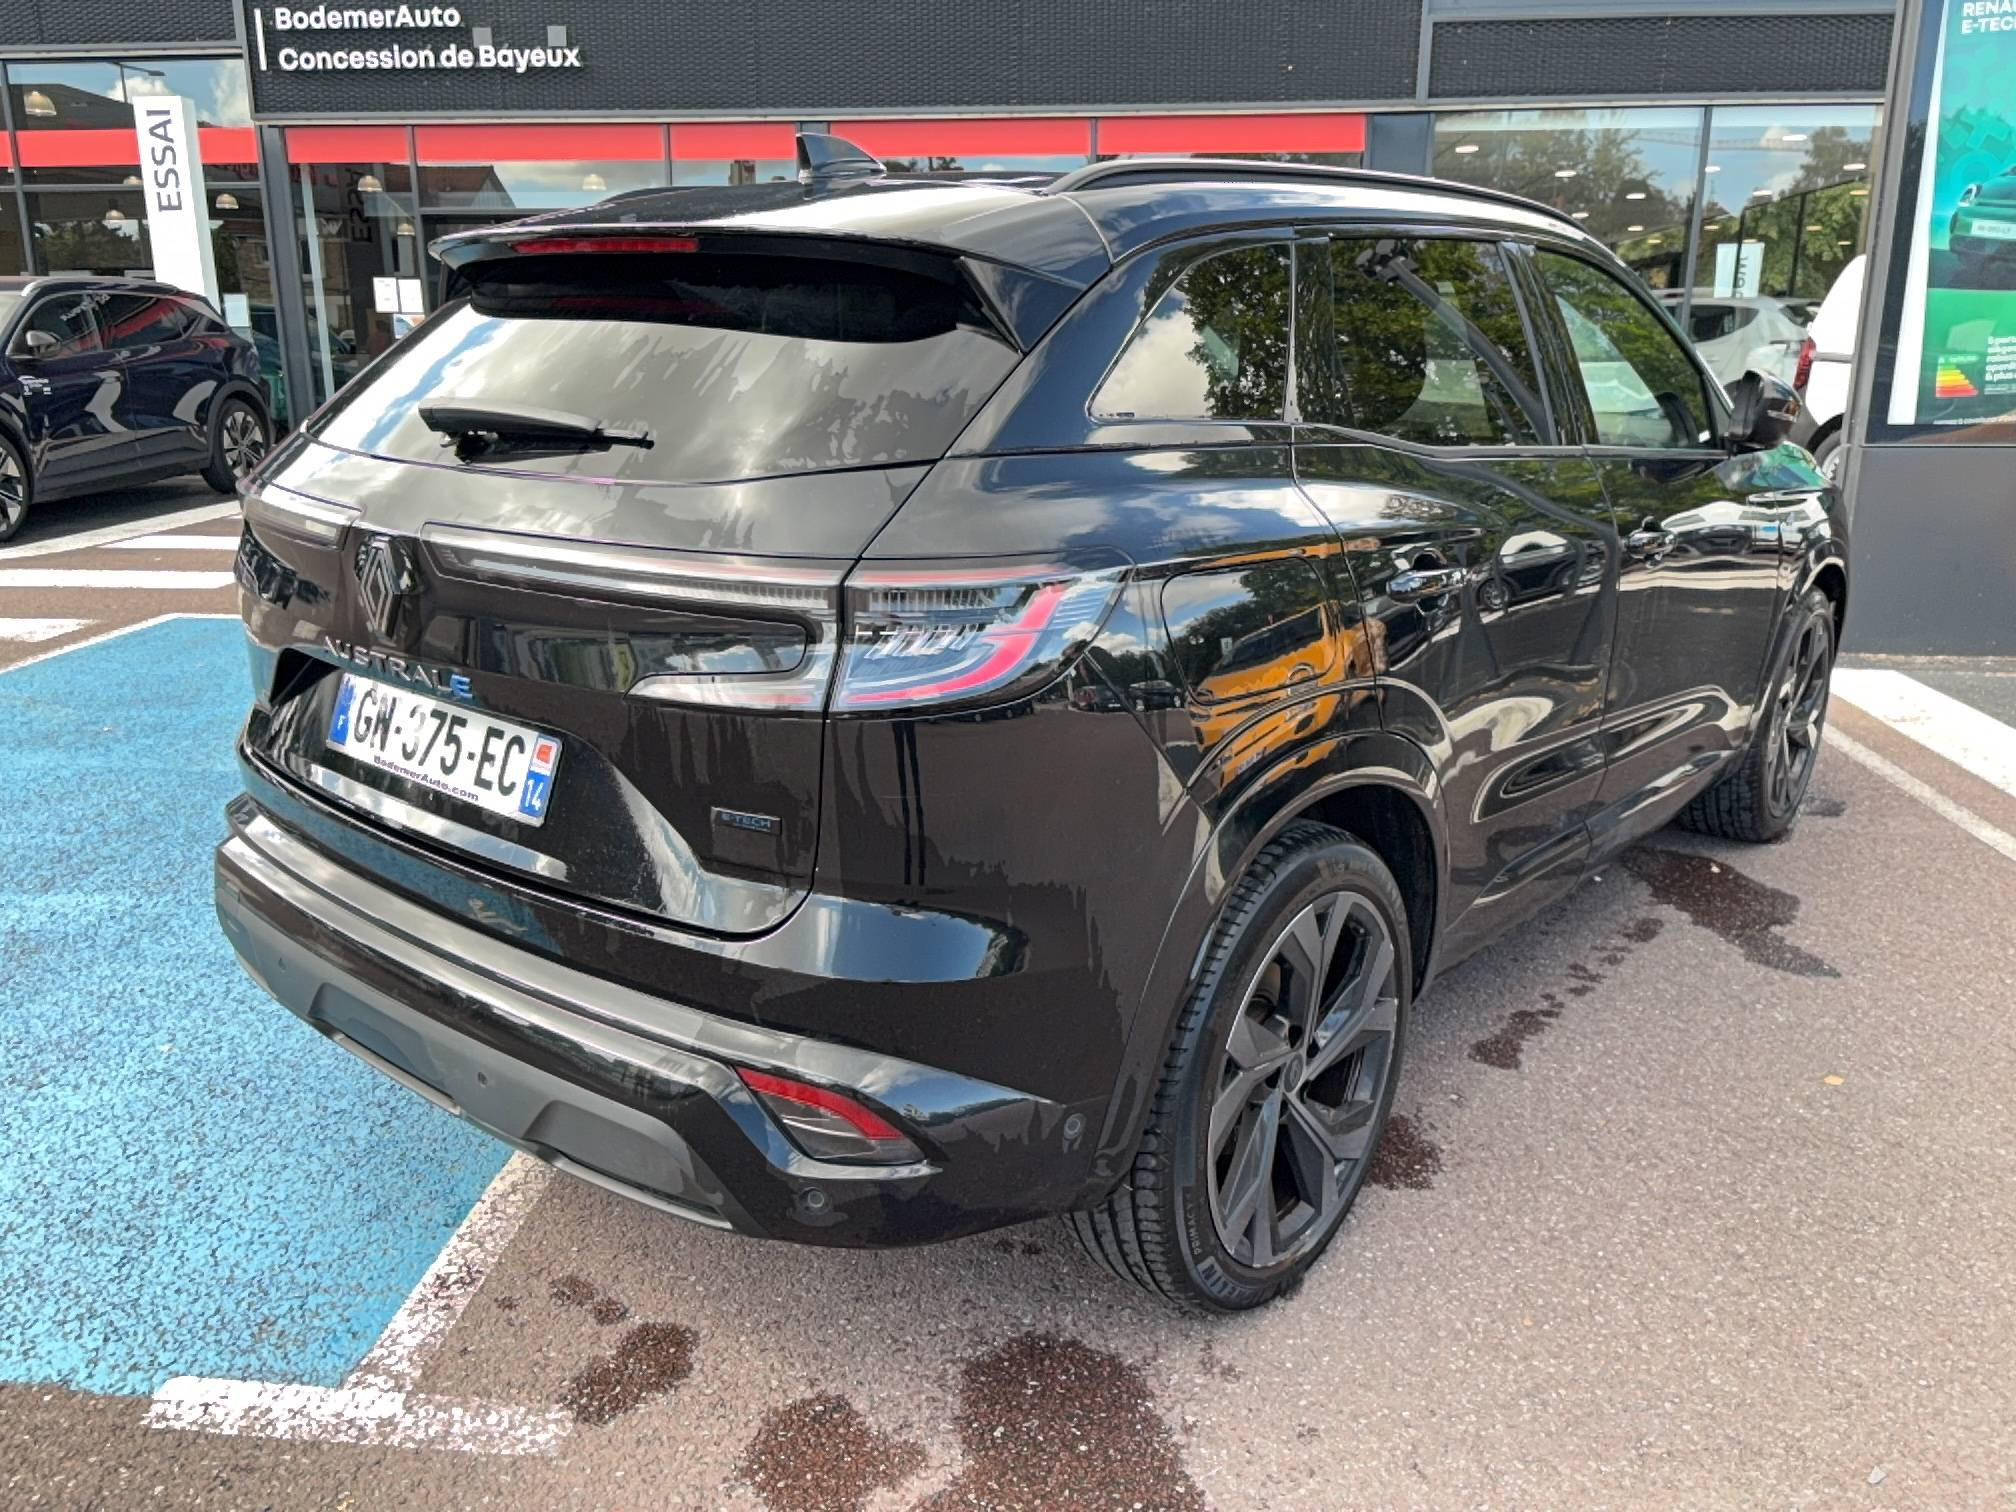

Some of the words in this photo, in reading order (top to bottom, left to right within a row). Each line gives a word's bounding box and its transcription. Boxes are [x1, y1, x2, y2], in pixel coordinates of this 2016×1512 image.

[274, 7, 462, 29] BodemerAuto
[1961, 15, 2016, 34] E-TEC
[278, 45, 435, 70] Concession
[440, 44, 474, 67] de
[478, 44, 582, 74] Bayeux
[146, 109, 183, 212] ESSAI
[353, 686, 526, 797] GN-375-EC
[373, 755, 479, 802] BodemerAuto.com
[525, 778, 543, 811] 14
[720, 813, 771, 829] E-TECH
